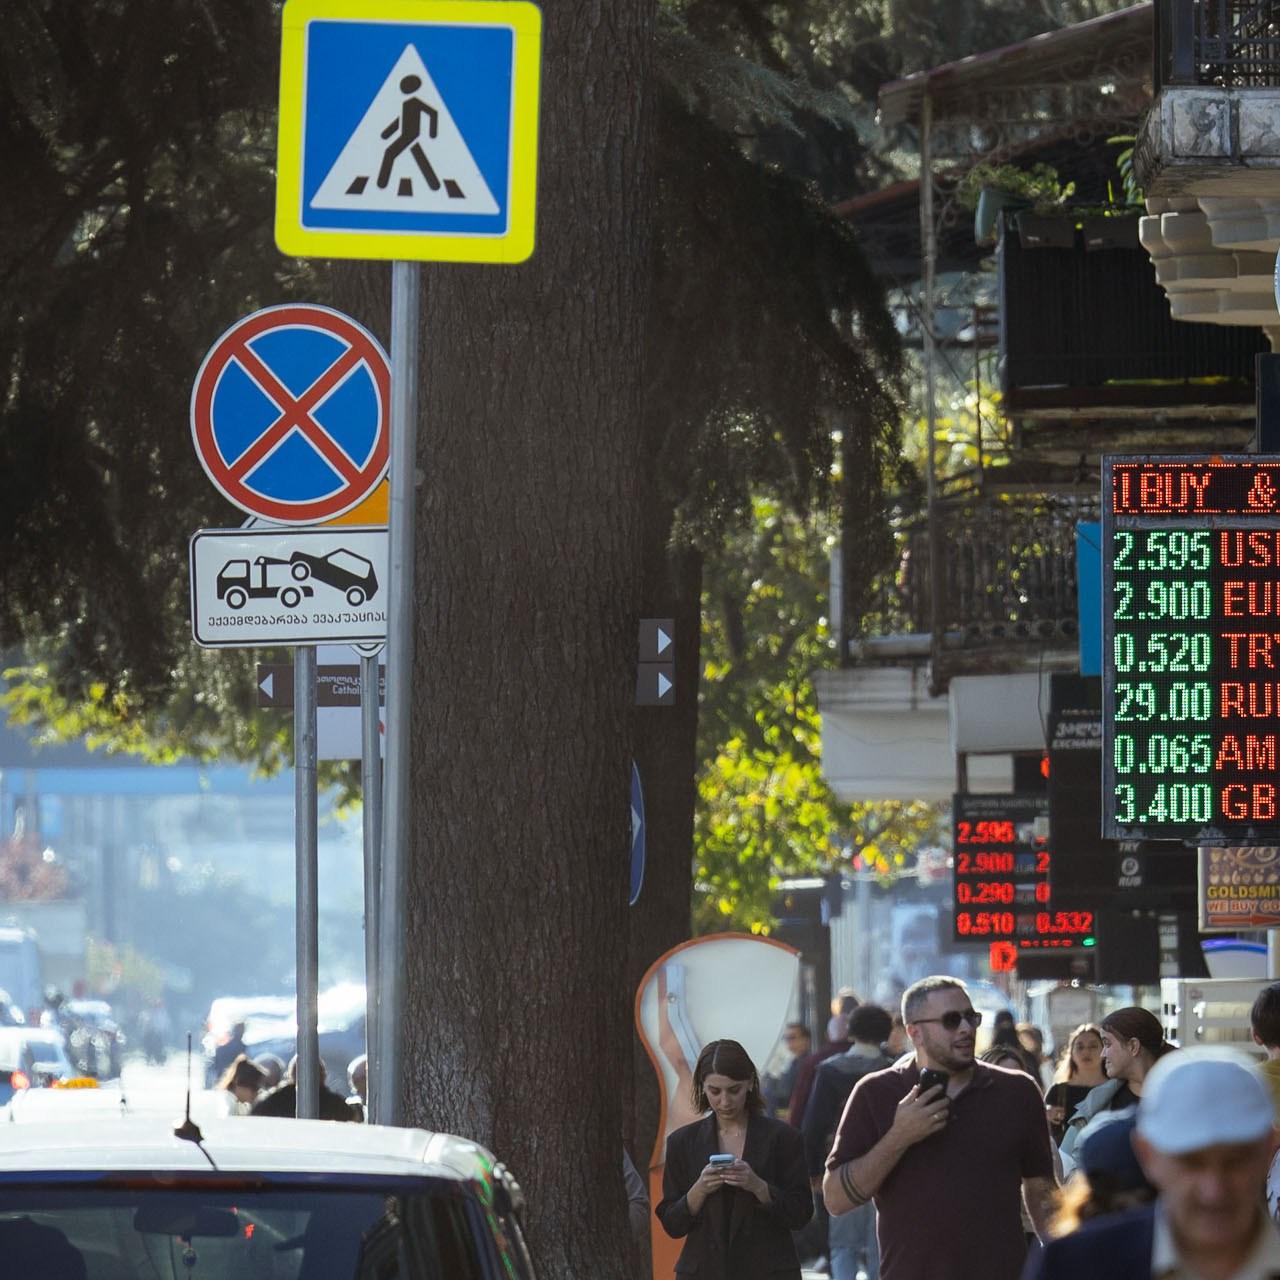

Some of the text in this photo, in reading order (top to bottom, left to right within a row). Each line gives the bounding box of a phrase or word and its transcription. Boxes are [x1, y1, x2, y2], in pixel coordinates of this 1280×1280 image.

[1247, 472, 1277, 508] &
[1113, 531, 1211, 570] 2.595
[1113, 580, 1211, 620] 2.900
[208, 614, 309, 627] ექვემდებარება
[1113, 632, 1211, 672] 0.520
[1114, 682, 1211, 722] 29.00
[1113, 734, 1212, 774] 0.065
[1114, 783, 1212, 823] 3.400
[1207, 900, 1228, 912] WE
[1231, 900, 1257, 912] BUY
